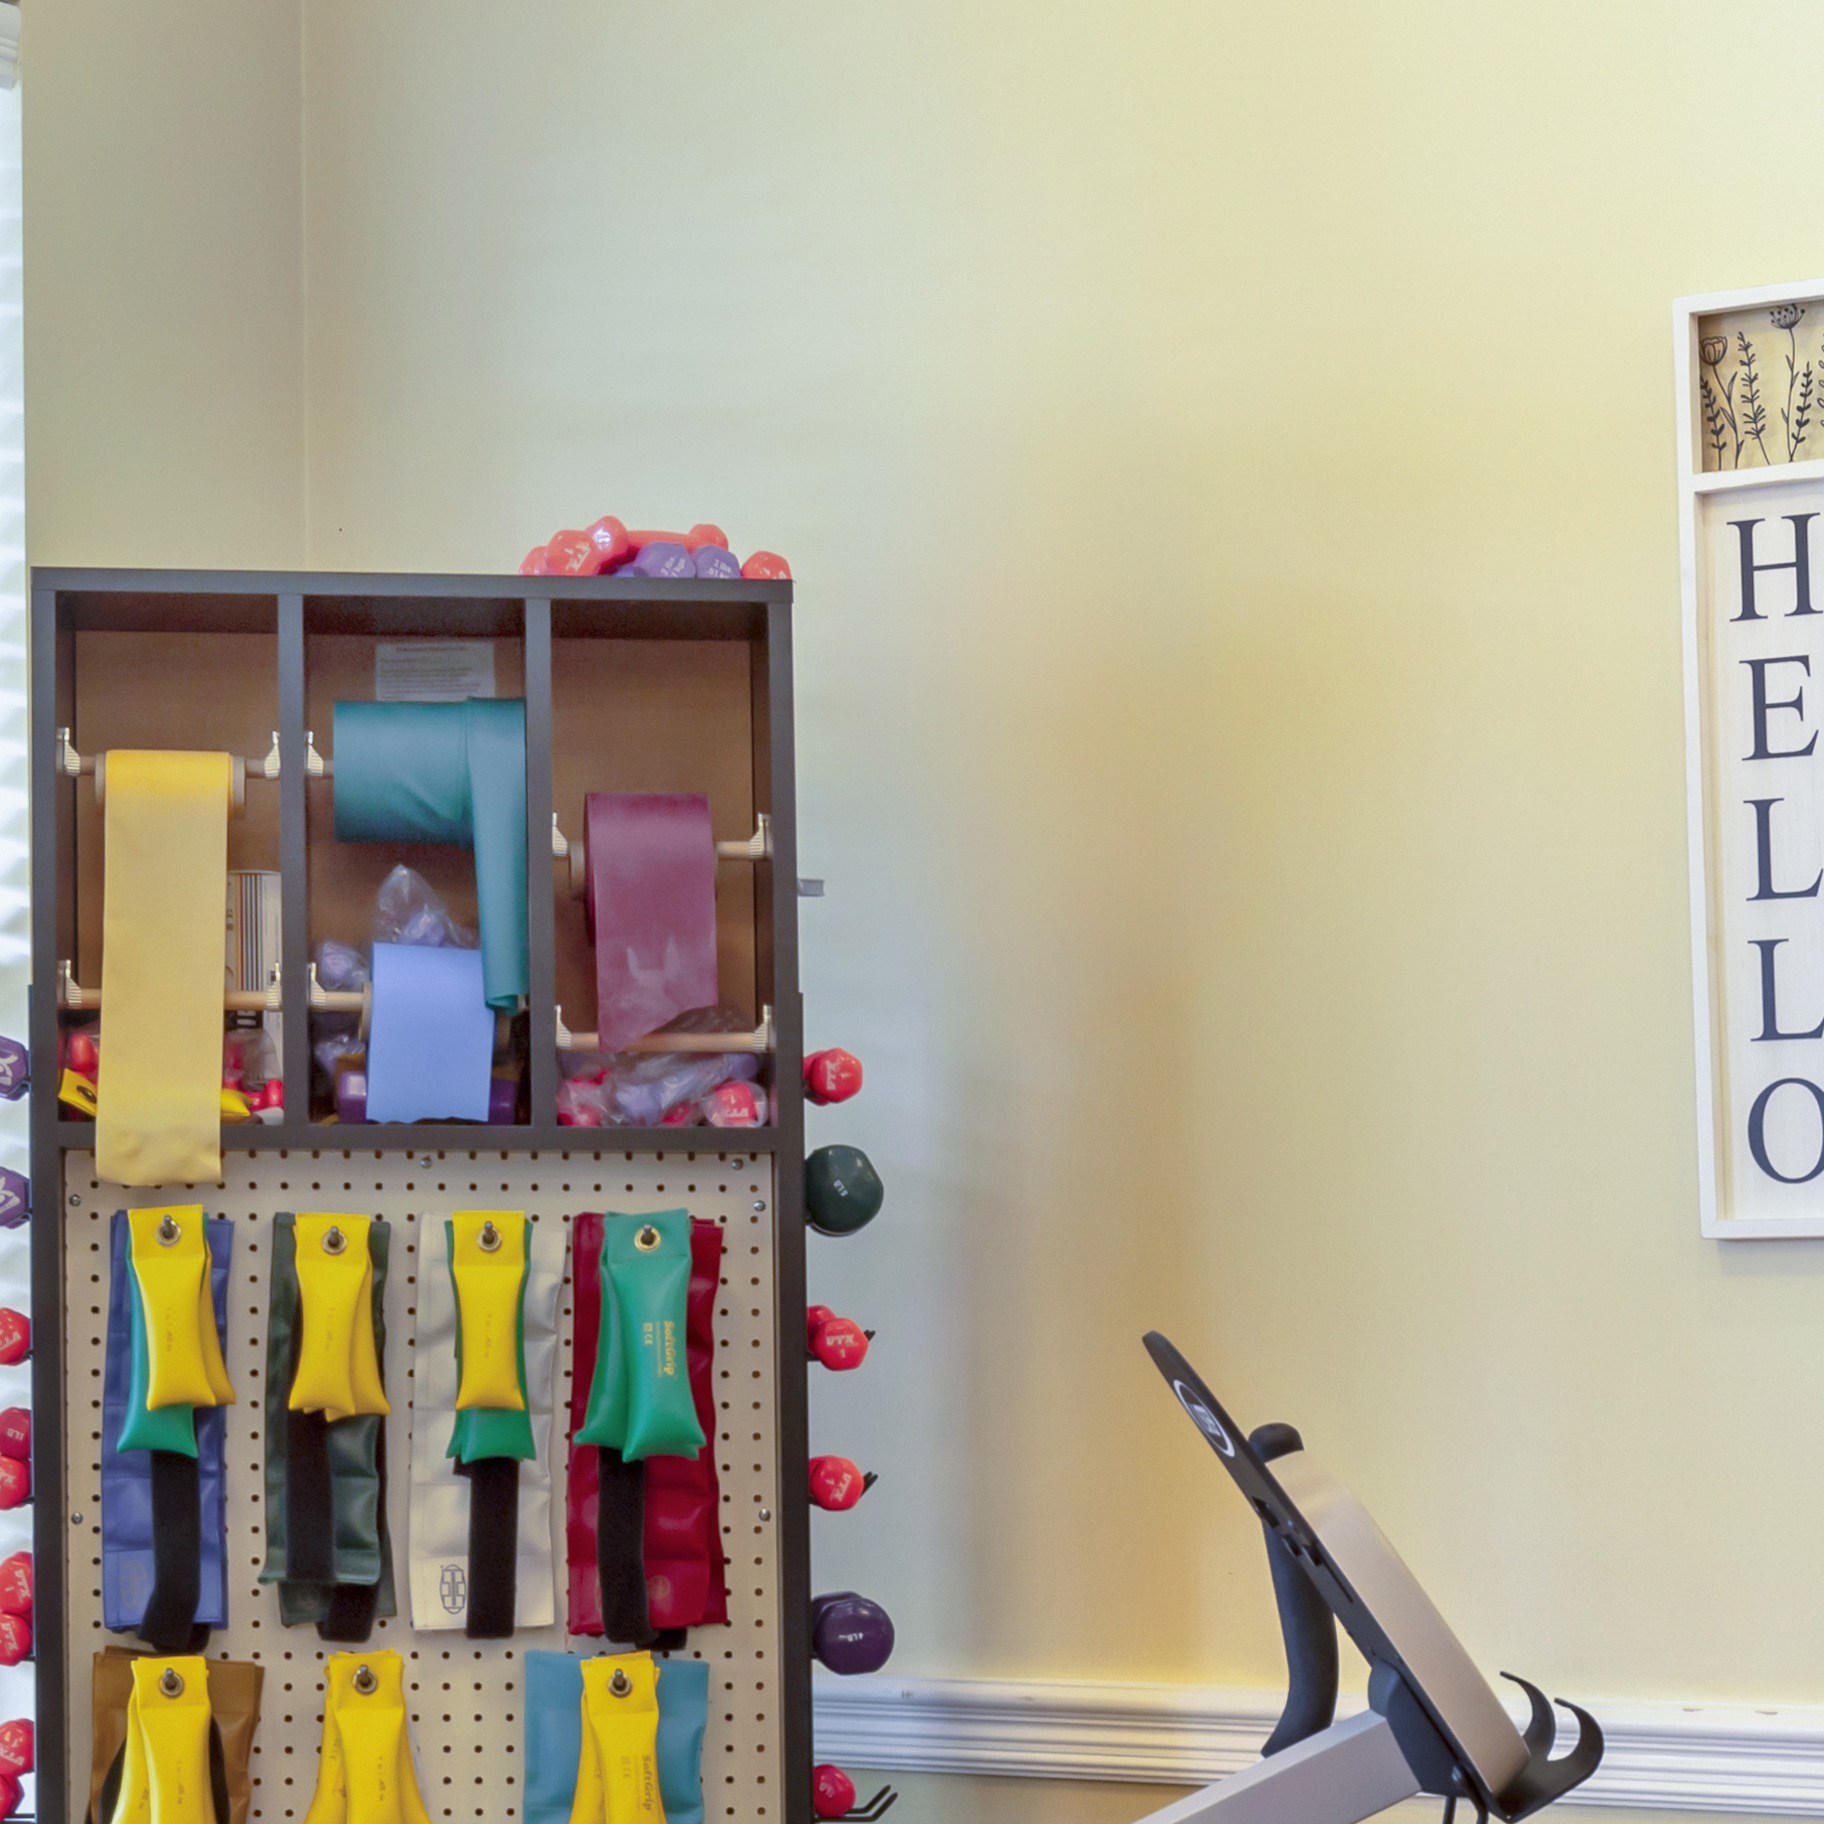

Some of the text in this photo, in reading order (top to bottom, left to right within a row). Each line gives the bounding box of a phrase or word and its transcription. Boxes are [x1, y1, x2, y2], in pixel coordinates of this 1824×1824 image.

[663, 1320, 676, 1376] SoftGrip
[826, 1333, 855, 1347] VTX
[642, 1754, 654, 1812] SoftGrip
